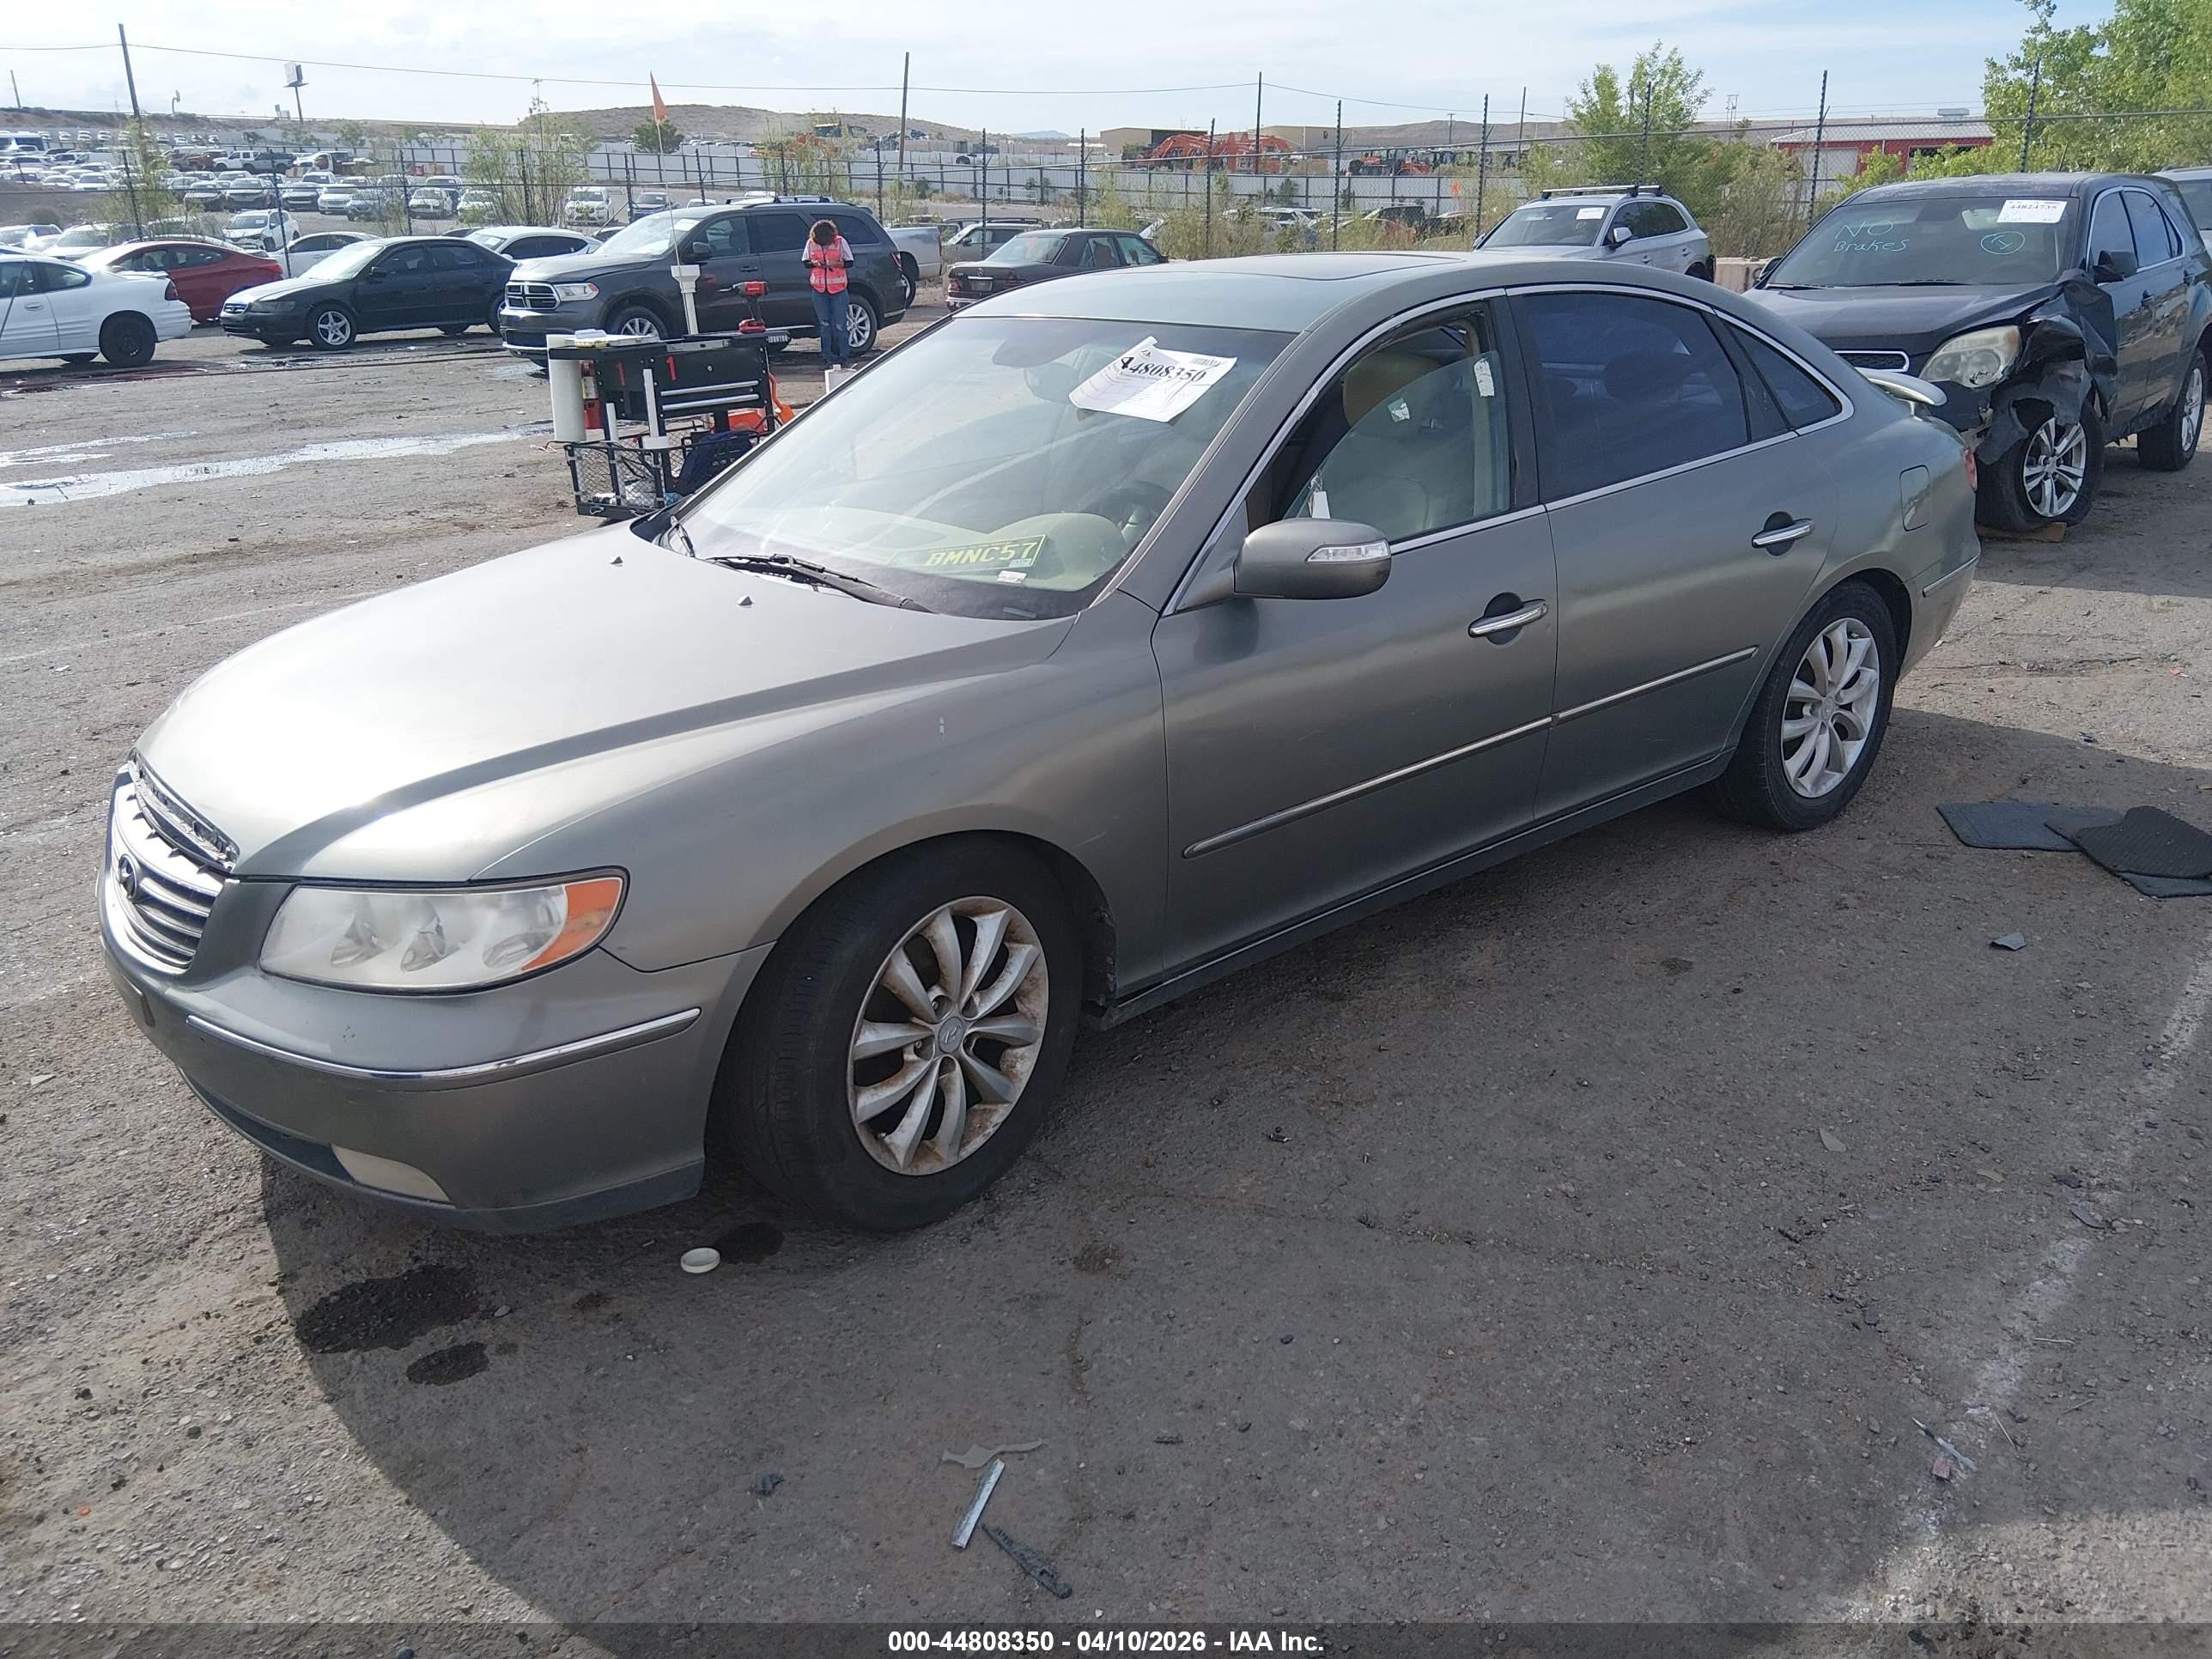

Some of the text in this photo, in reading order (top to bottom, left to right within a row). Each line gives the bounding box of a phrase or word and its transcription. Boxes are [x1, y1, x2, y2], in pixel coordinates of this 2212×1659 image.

[1834, 239, 1910, 252] Brakes
[666, 356, 677, 381] 1
[1121, 356, 1206, 382] 44808350
[924, 542, 1037, 567] BMNC57
